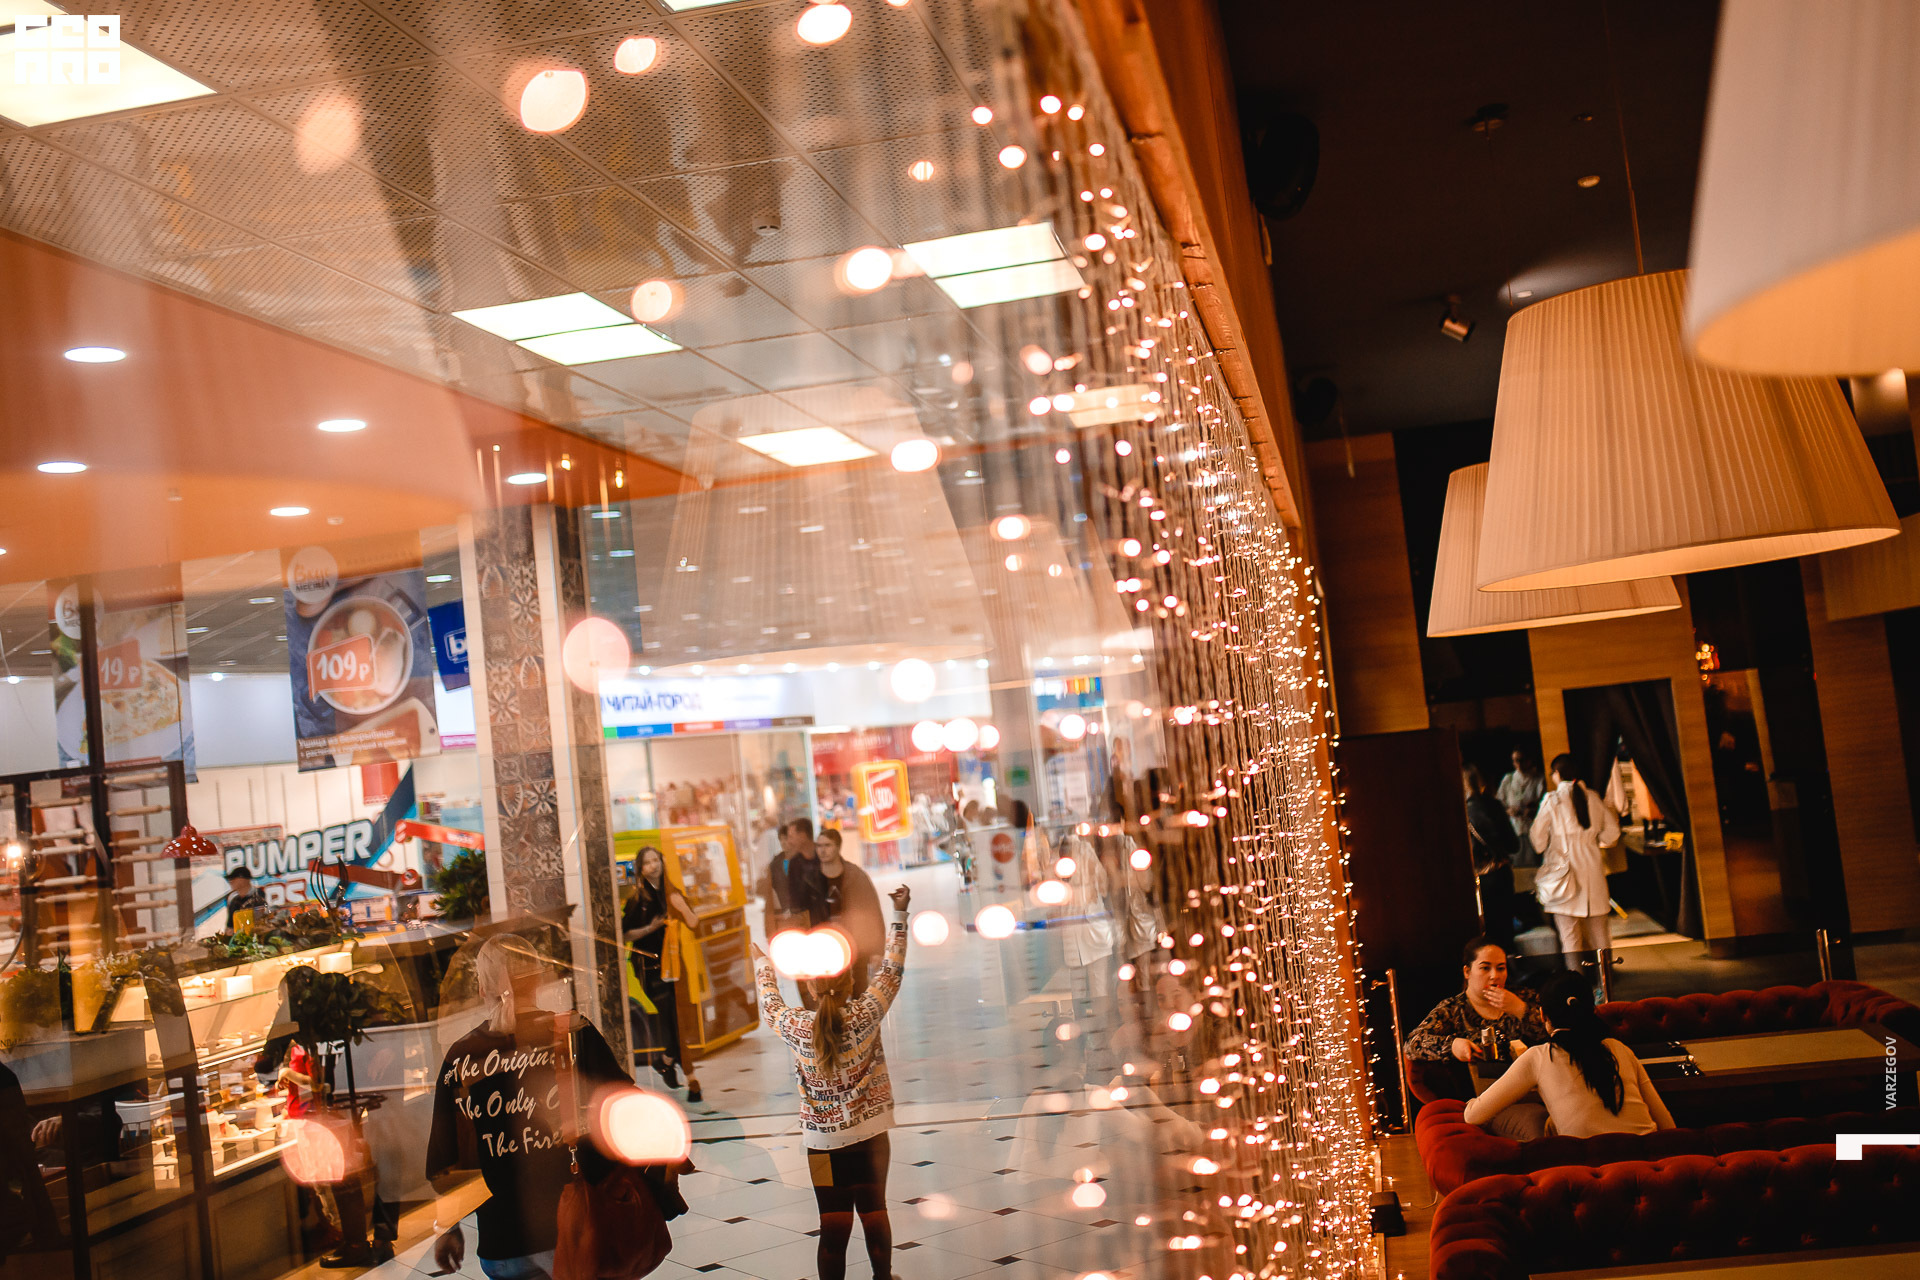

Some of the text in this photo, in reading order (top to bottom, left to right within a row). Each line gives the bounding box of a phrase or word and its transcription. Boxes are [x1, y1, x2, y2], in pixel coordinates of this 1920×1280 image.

[452, 1054, 480, 1082] The
[455, 1095, 482, 1120] The
[486, 1087, 536, 1120] Only
[482, 1131, 519, 1157] The
